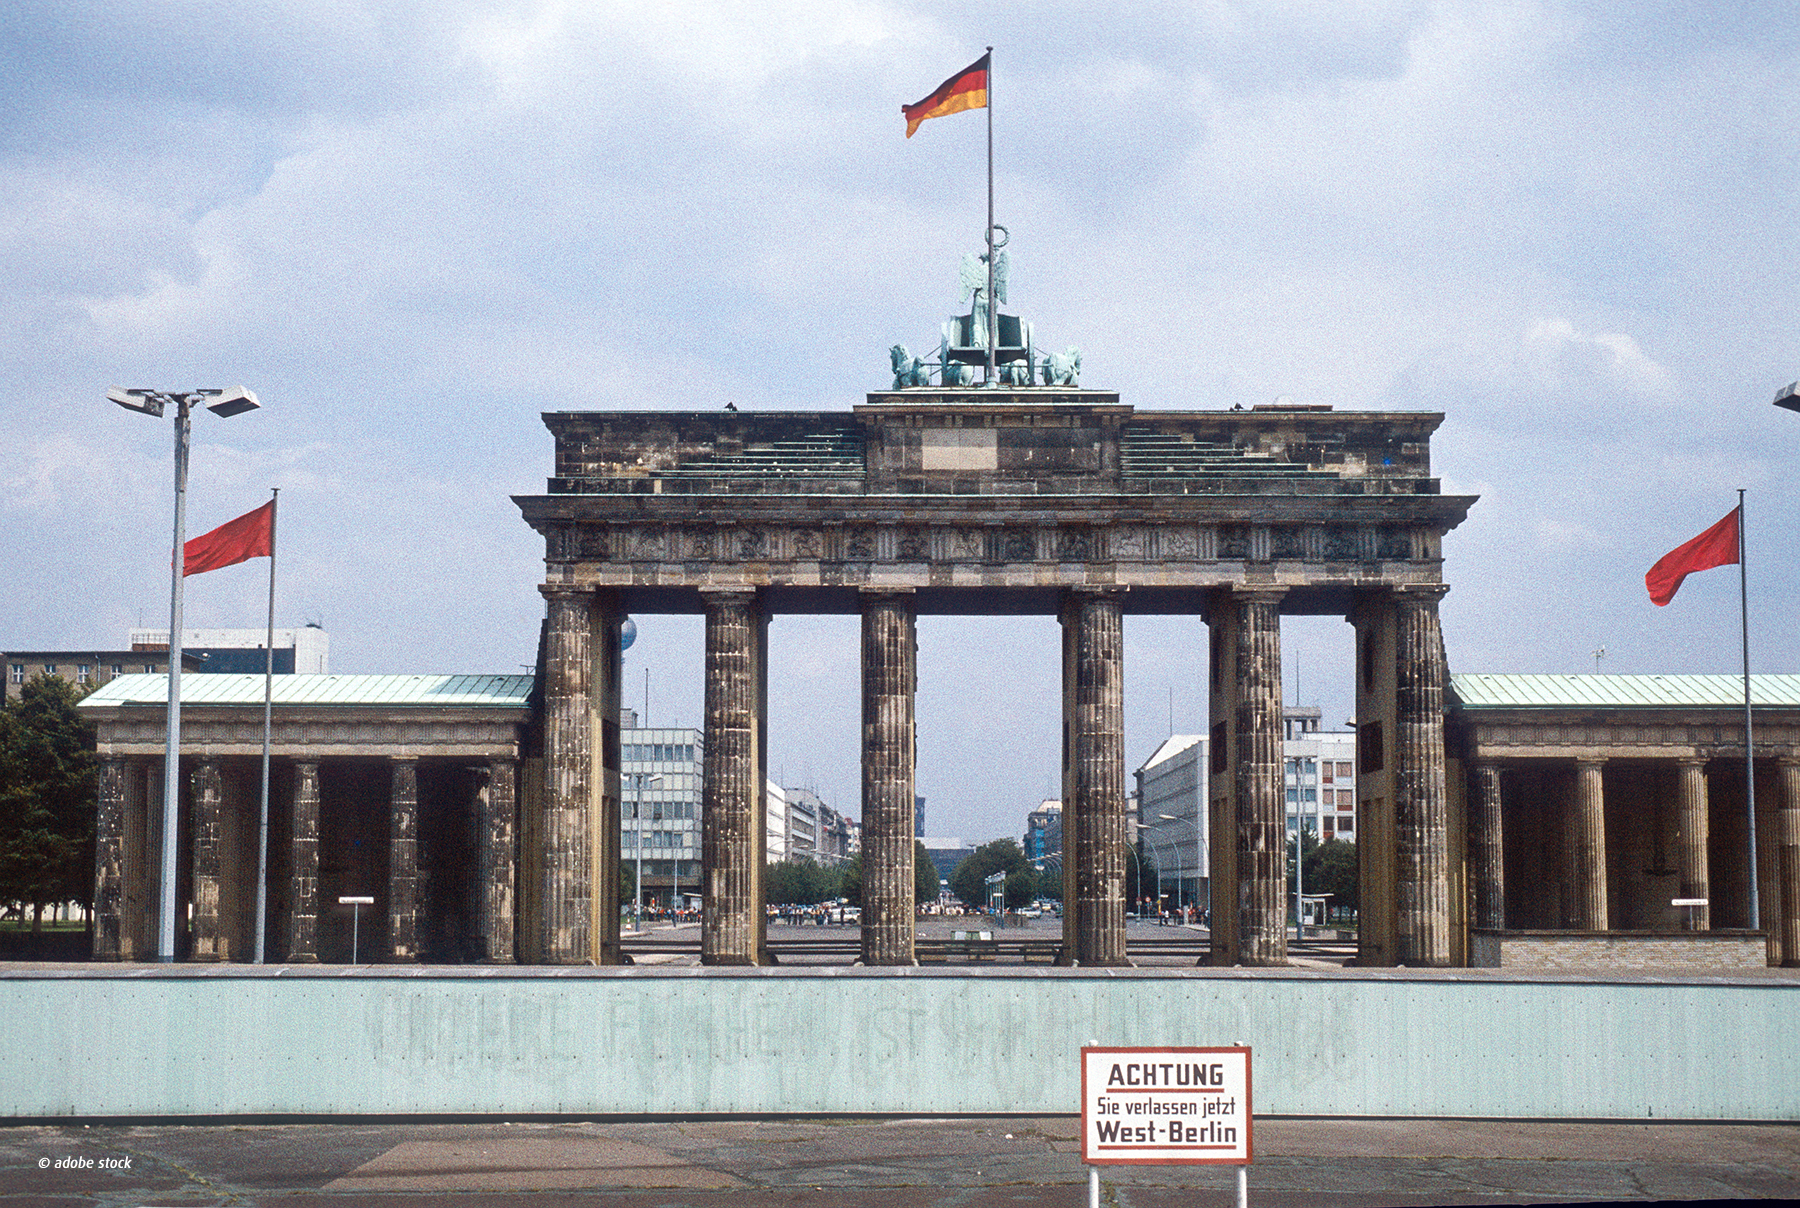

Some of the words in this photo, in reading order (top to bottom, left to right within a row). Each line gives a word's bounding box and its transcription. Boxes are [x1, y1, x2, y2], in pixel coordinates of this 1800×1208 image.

[1108, 1063, 1223, 1086] ACHTUNG
[1097, 1096, 1120, 1115] Sie
[1125, 1096, 1197, 1115] verlassen
[1202, 1096, 1236, 1119] jetzt
[1096, 1120, 1237, 1143] West-Berlin
